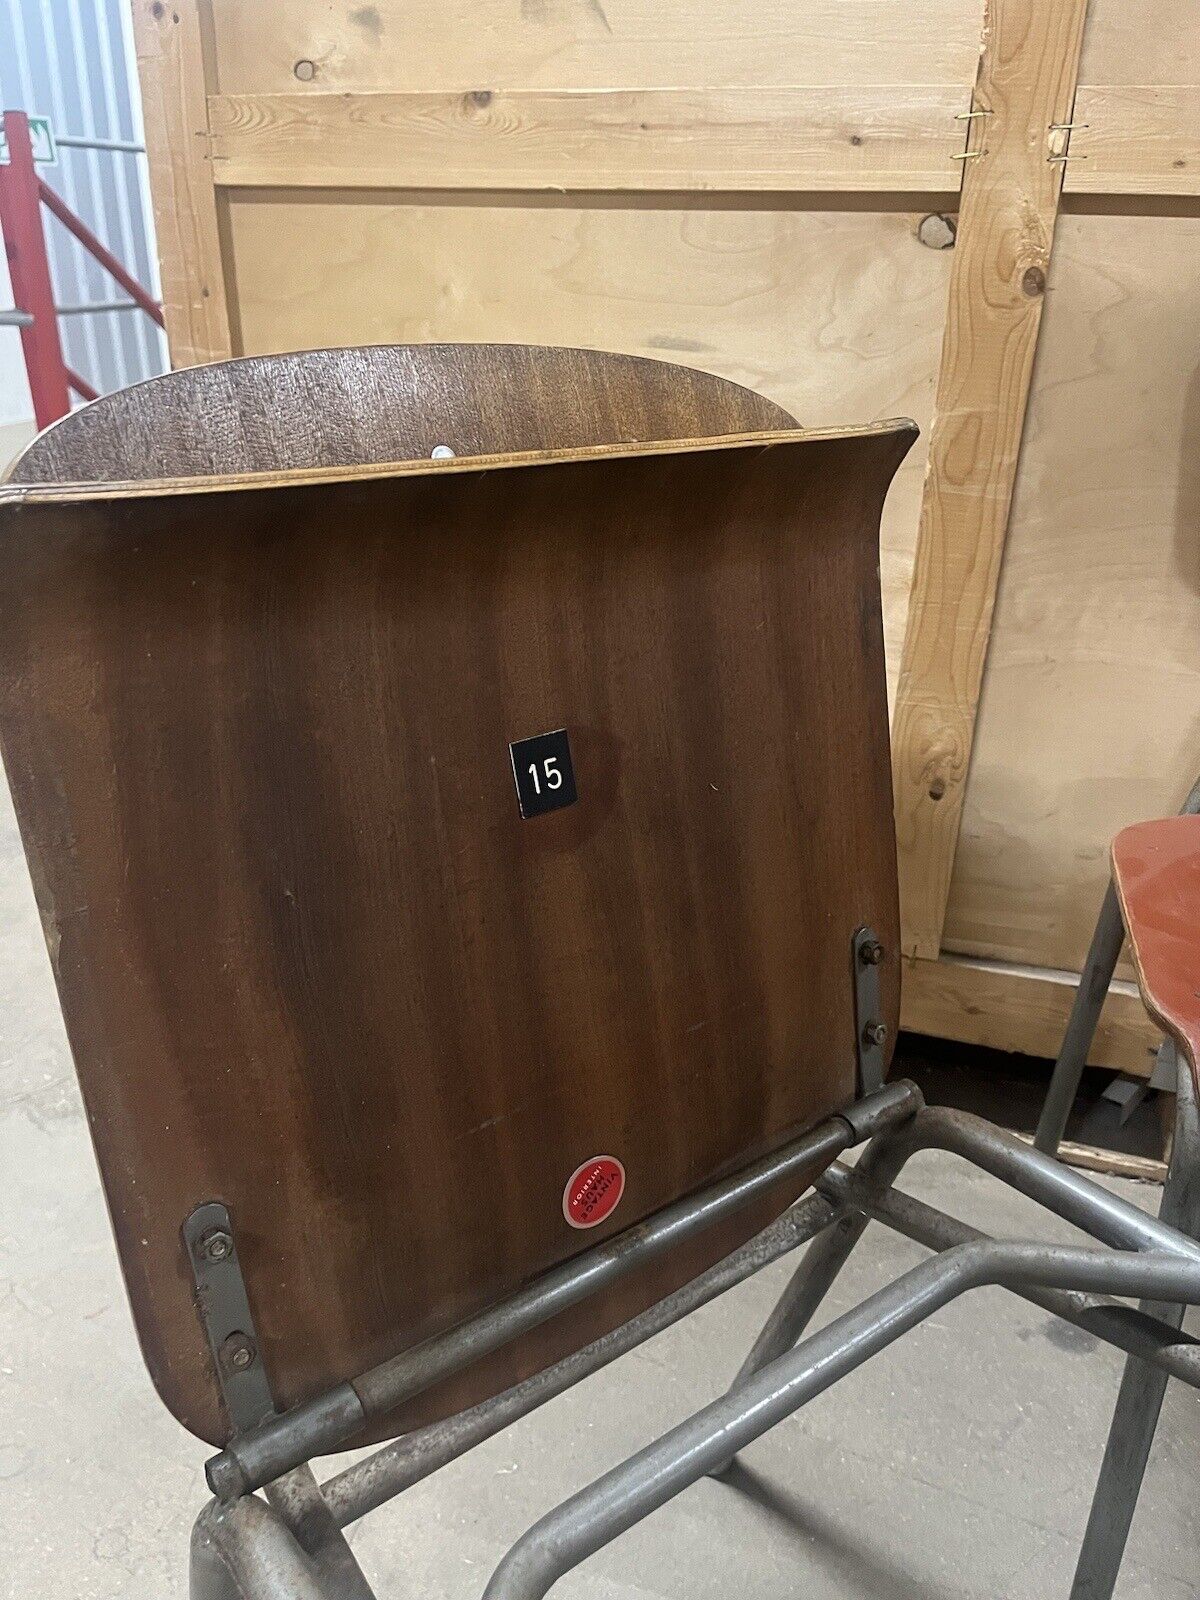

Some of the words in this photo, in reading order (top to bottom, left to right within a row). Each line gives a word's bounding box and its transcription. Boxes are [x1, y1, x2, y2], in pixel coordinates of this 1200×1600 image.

[528, 757, 563, 795] 15
[572, 1165, 603, 1206] INTERIOR
[580, 1171, 619, 1219] VINTAGE
[581, 1174, 605, 1207] HAUS
